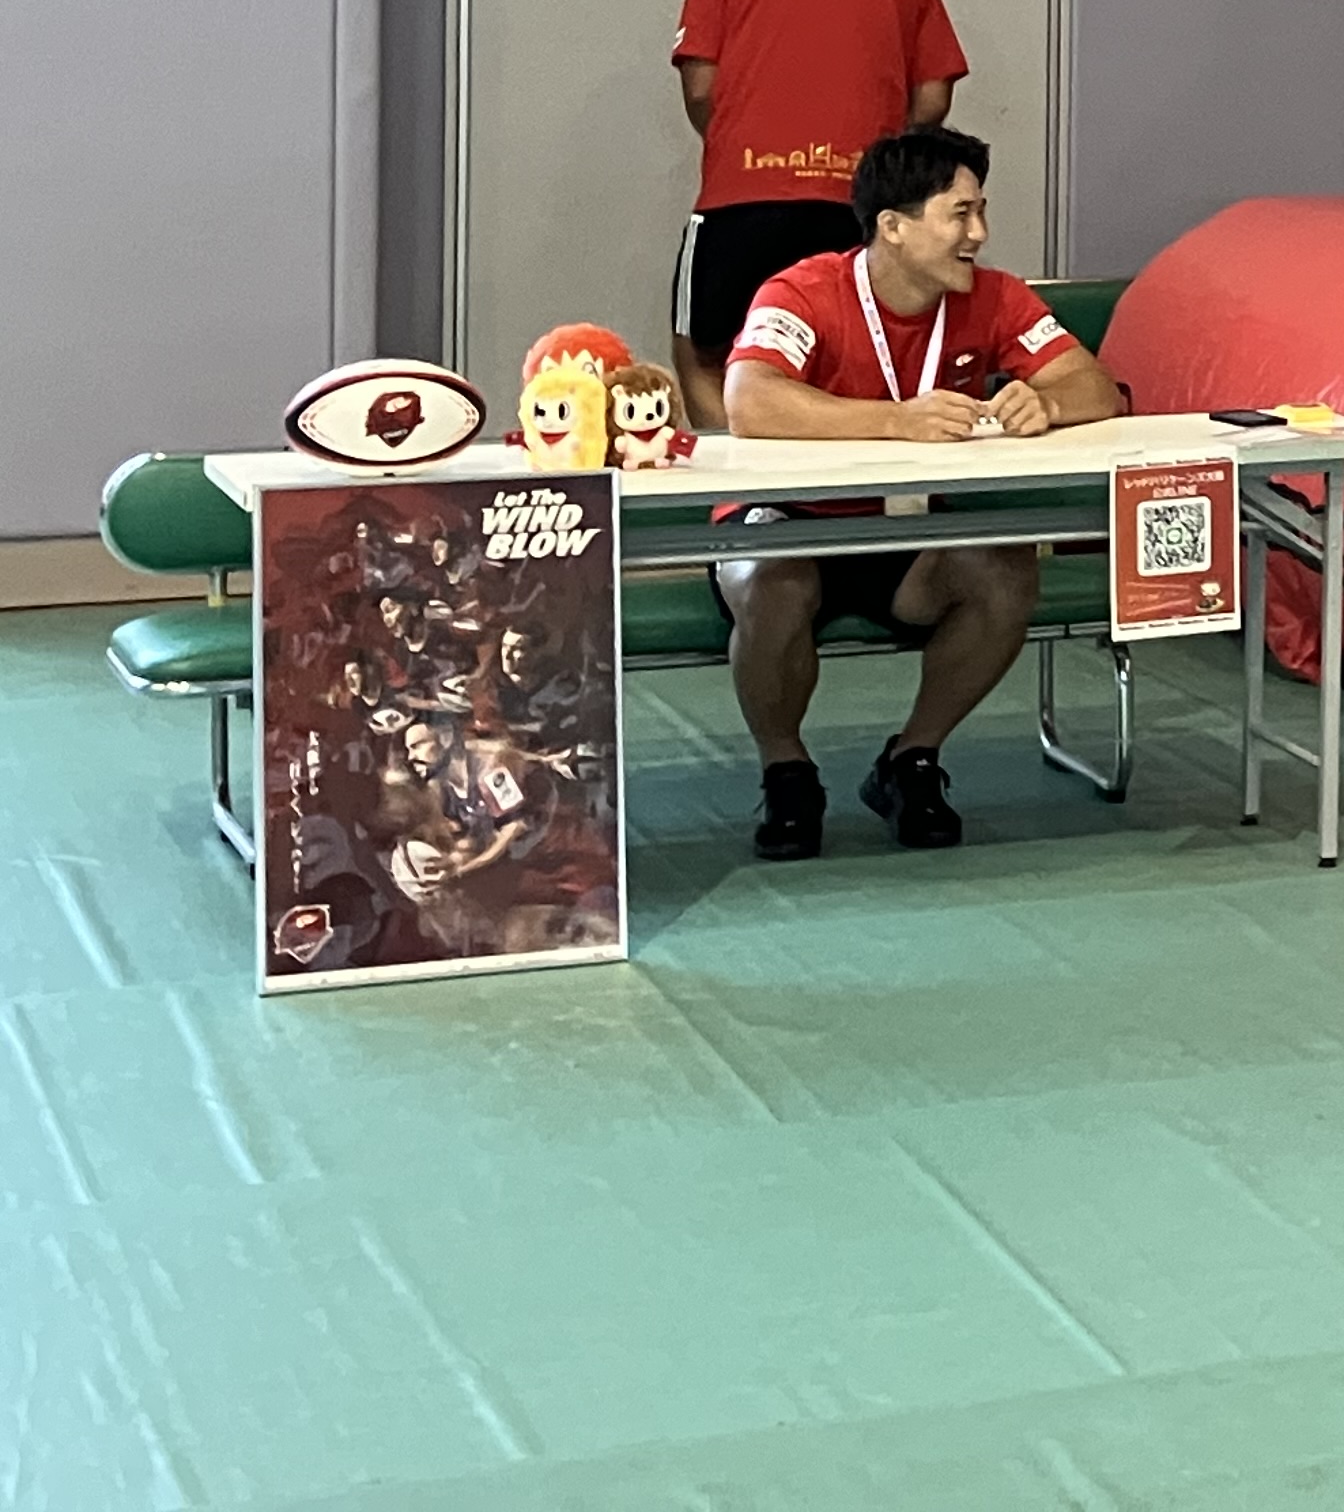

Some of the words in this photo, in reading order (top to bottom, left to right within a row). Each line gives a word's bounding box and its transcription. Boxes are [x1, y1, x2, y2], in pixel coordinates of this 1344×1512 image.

[493, 491, 528, 507] Let
[530, 488, 567, 506] The
[481, 504, 583, 535] WIND
[485, 529, 605, 560] BLOW
